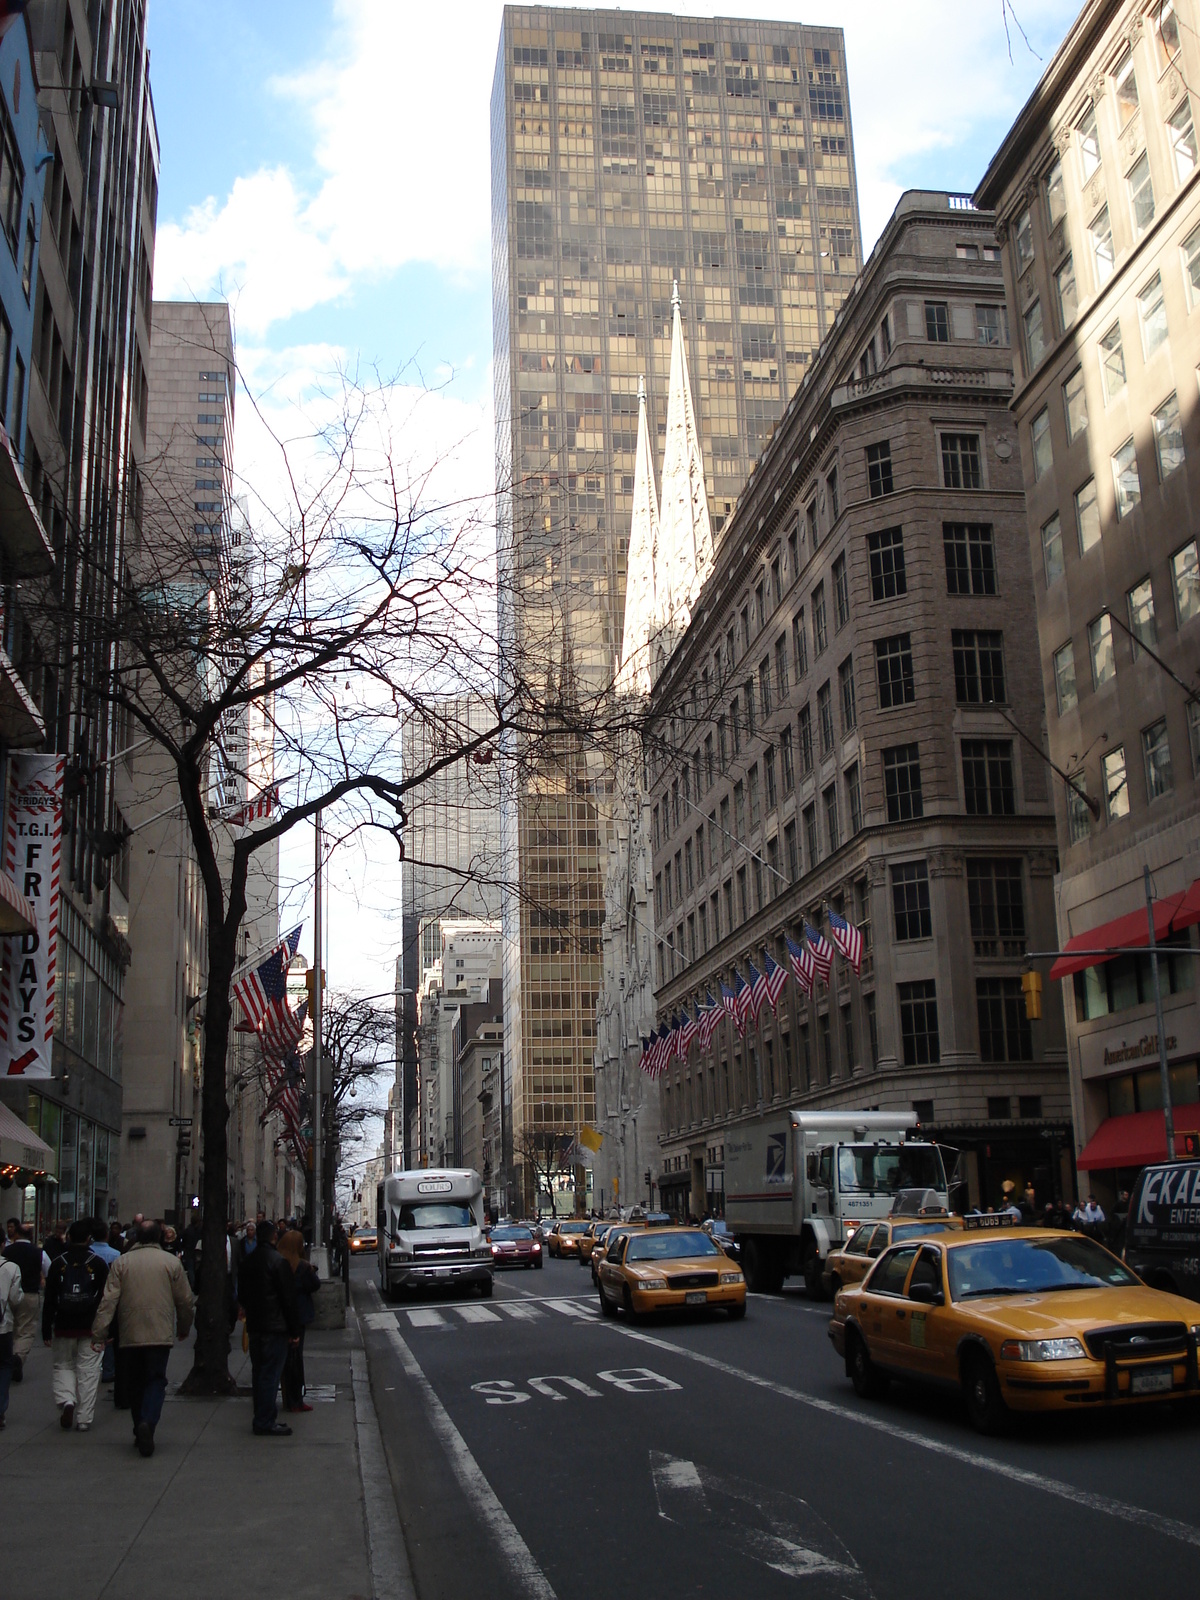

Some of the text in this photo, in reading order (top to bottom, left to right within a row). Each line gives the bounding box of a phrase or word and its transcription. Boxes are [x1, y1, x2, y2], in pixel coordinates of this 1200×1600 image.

[17, 822, 53, 837] T.G.I.
[17, 843, 42, 1043] FRDAY'S
[1104, 1041, 1140, 1066] American
[420, 1183, 450, 1191] TOURS
[470, 1367, 683, 1405] BUS
